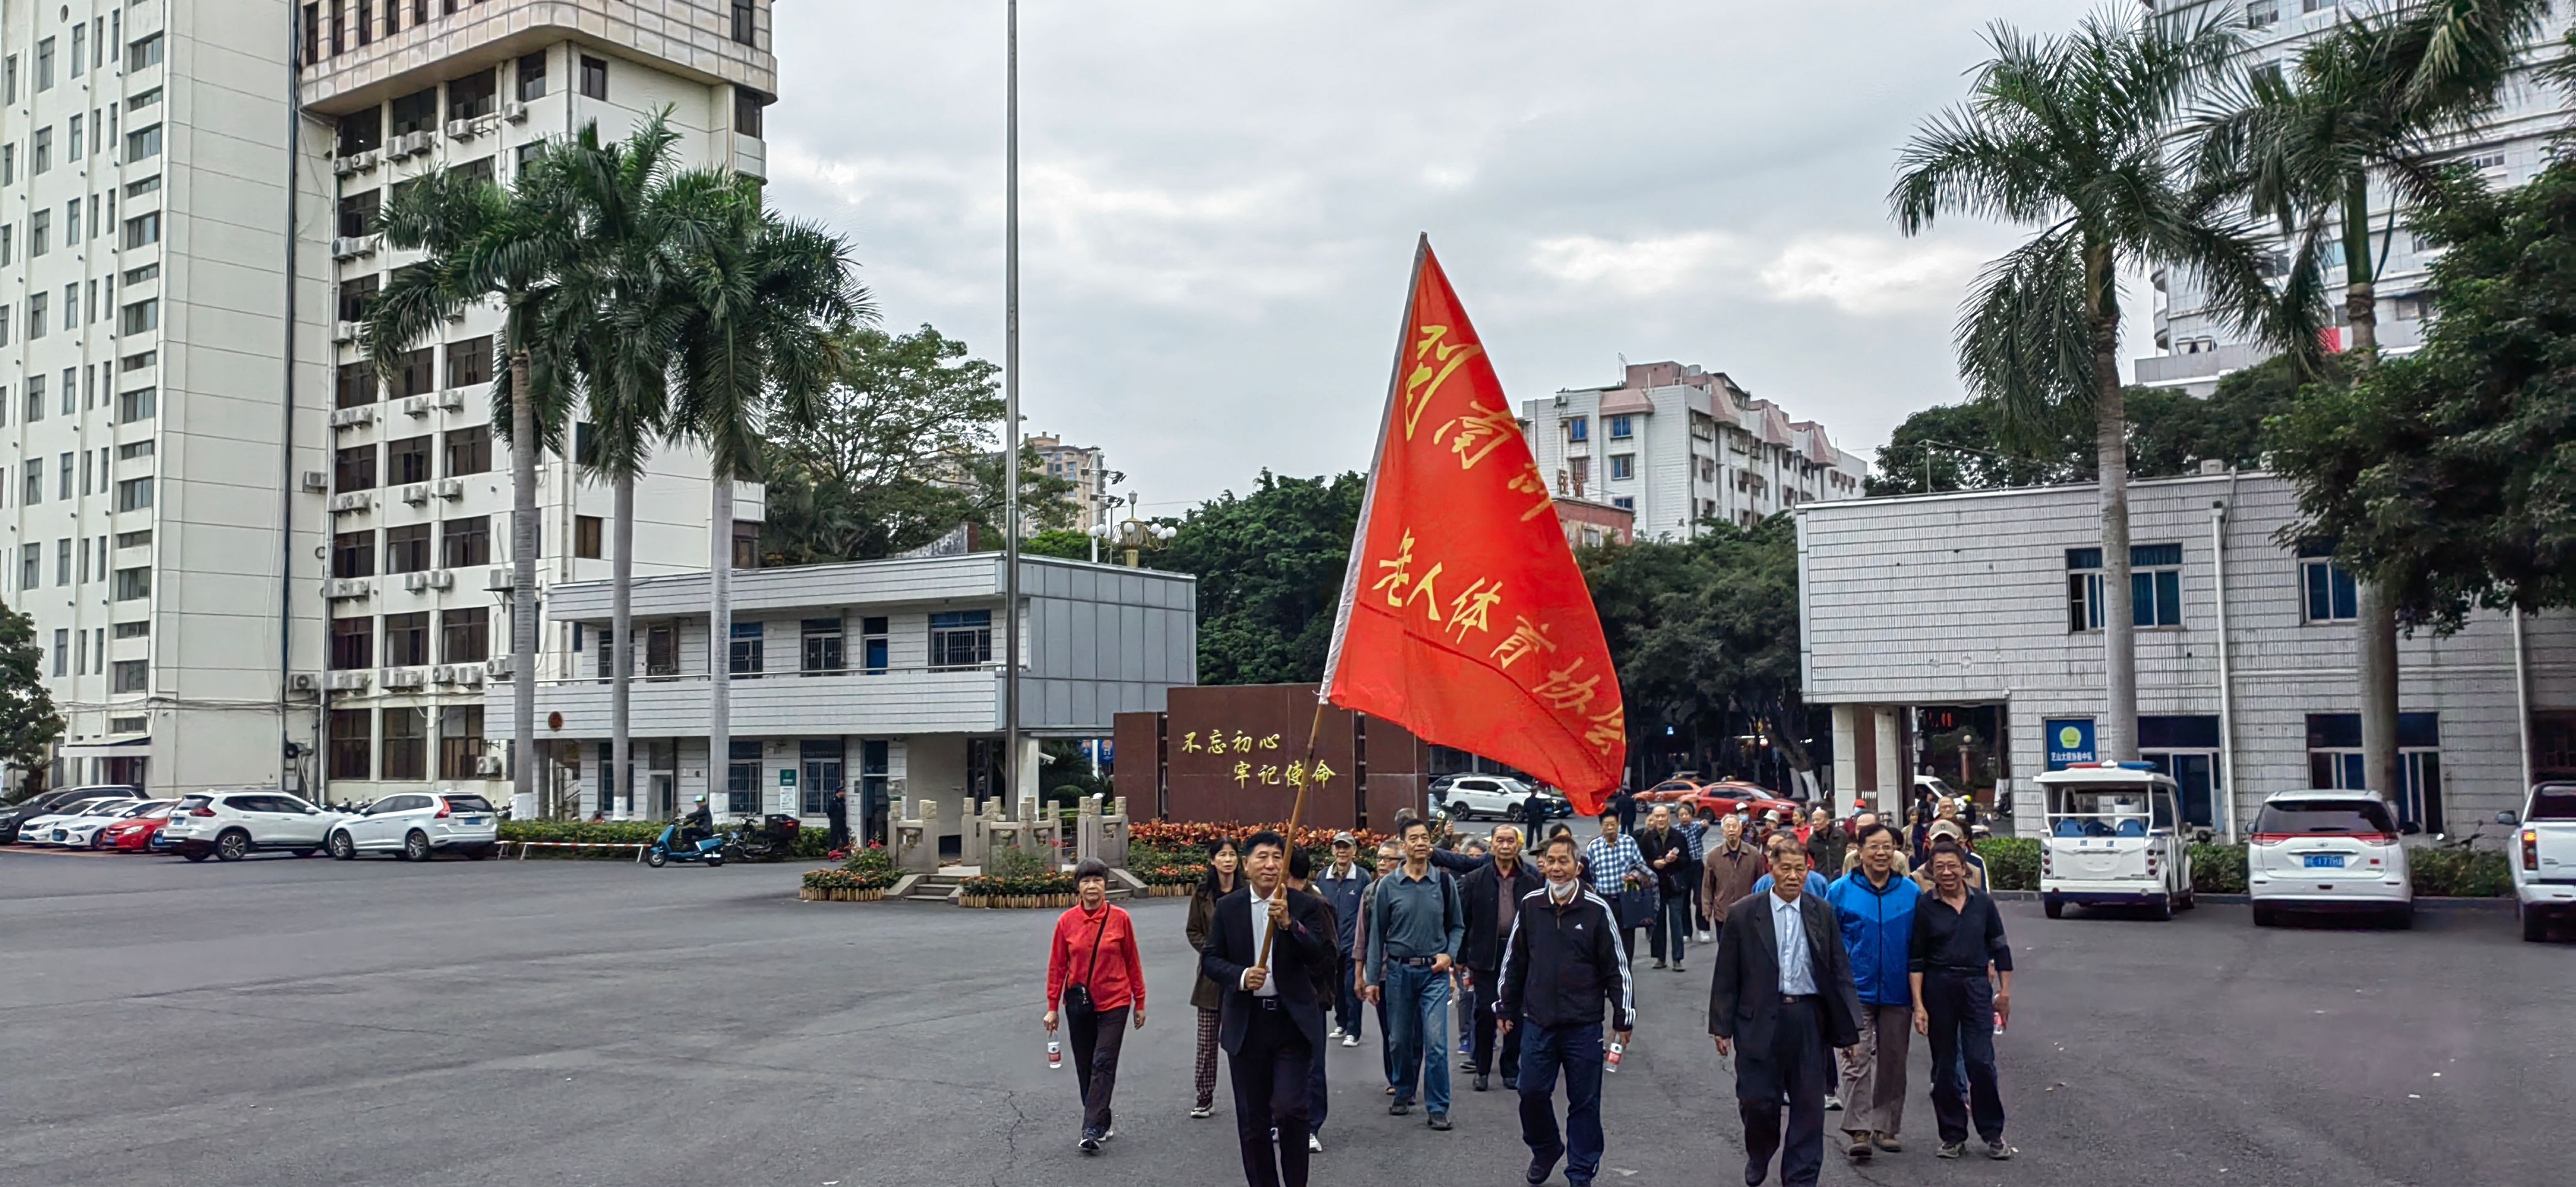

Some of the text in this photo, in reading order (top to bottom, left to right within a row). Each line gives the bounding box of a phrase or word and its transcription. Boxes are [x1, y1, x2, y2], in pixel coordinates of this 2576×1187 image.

[1182, 729, 1281, 754] 不忘初心
[1233, 759, 1336, 790] 牢记使命
